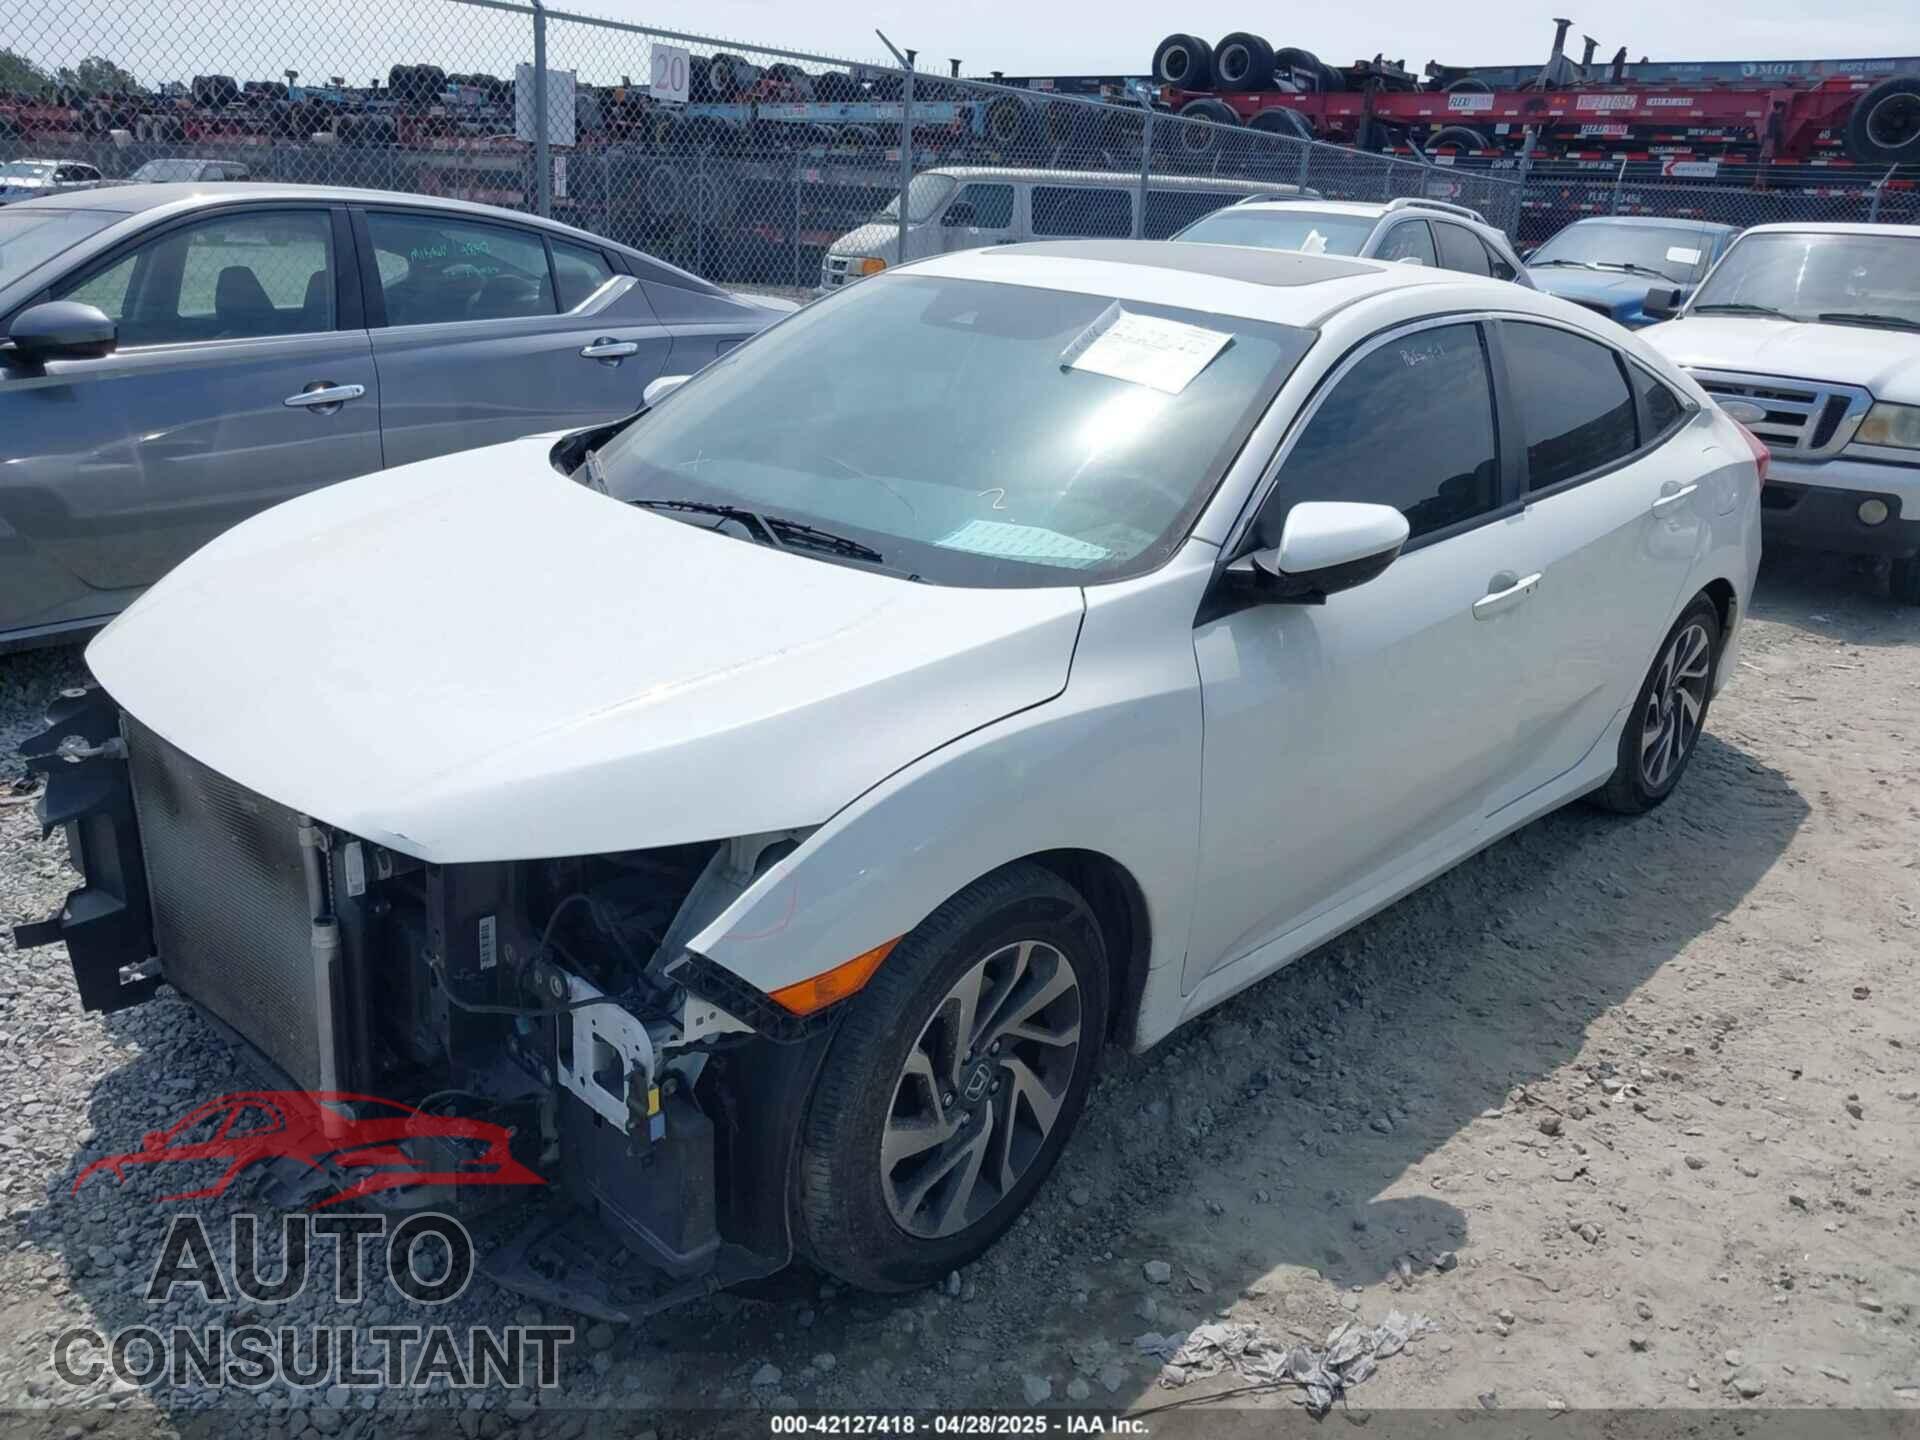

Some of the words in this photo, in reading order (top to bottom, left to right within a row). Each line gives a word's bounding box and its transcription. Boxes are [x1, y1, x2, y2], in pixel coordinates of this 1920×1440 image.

[654, 53, 685, 92] 20
[1757, 63, 1796, 76] MOL
[977, 487, 1008, 510] 2
